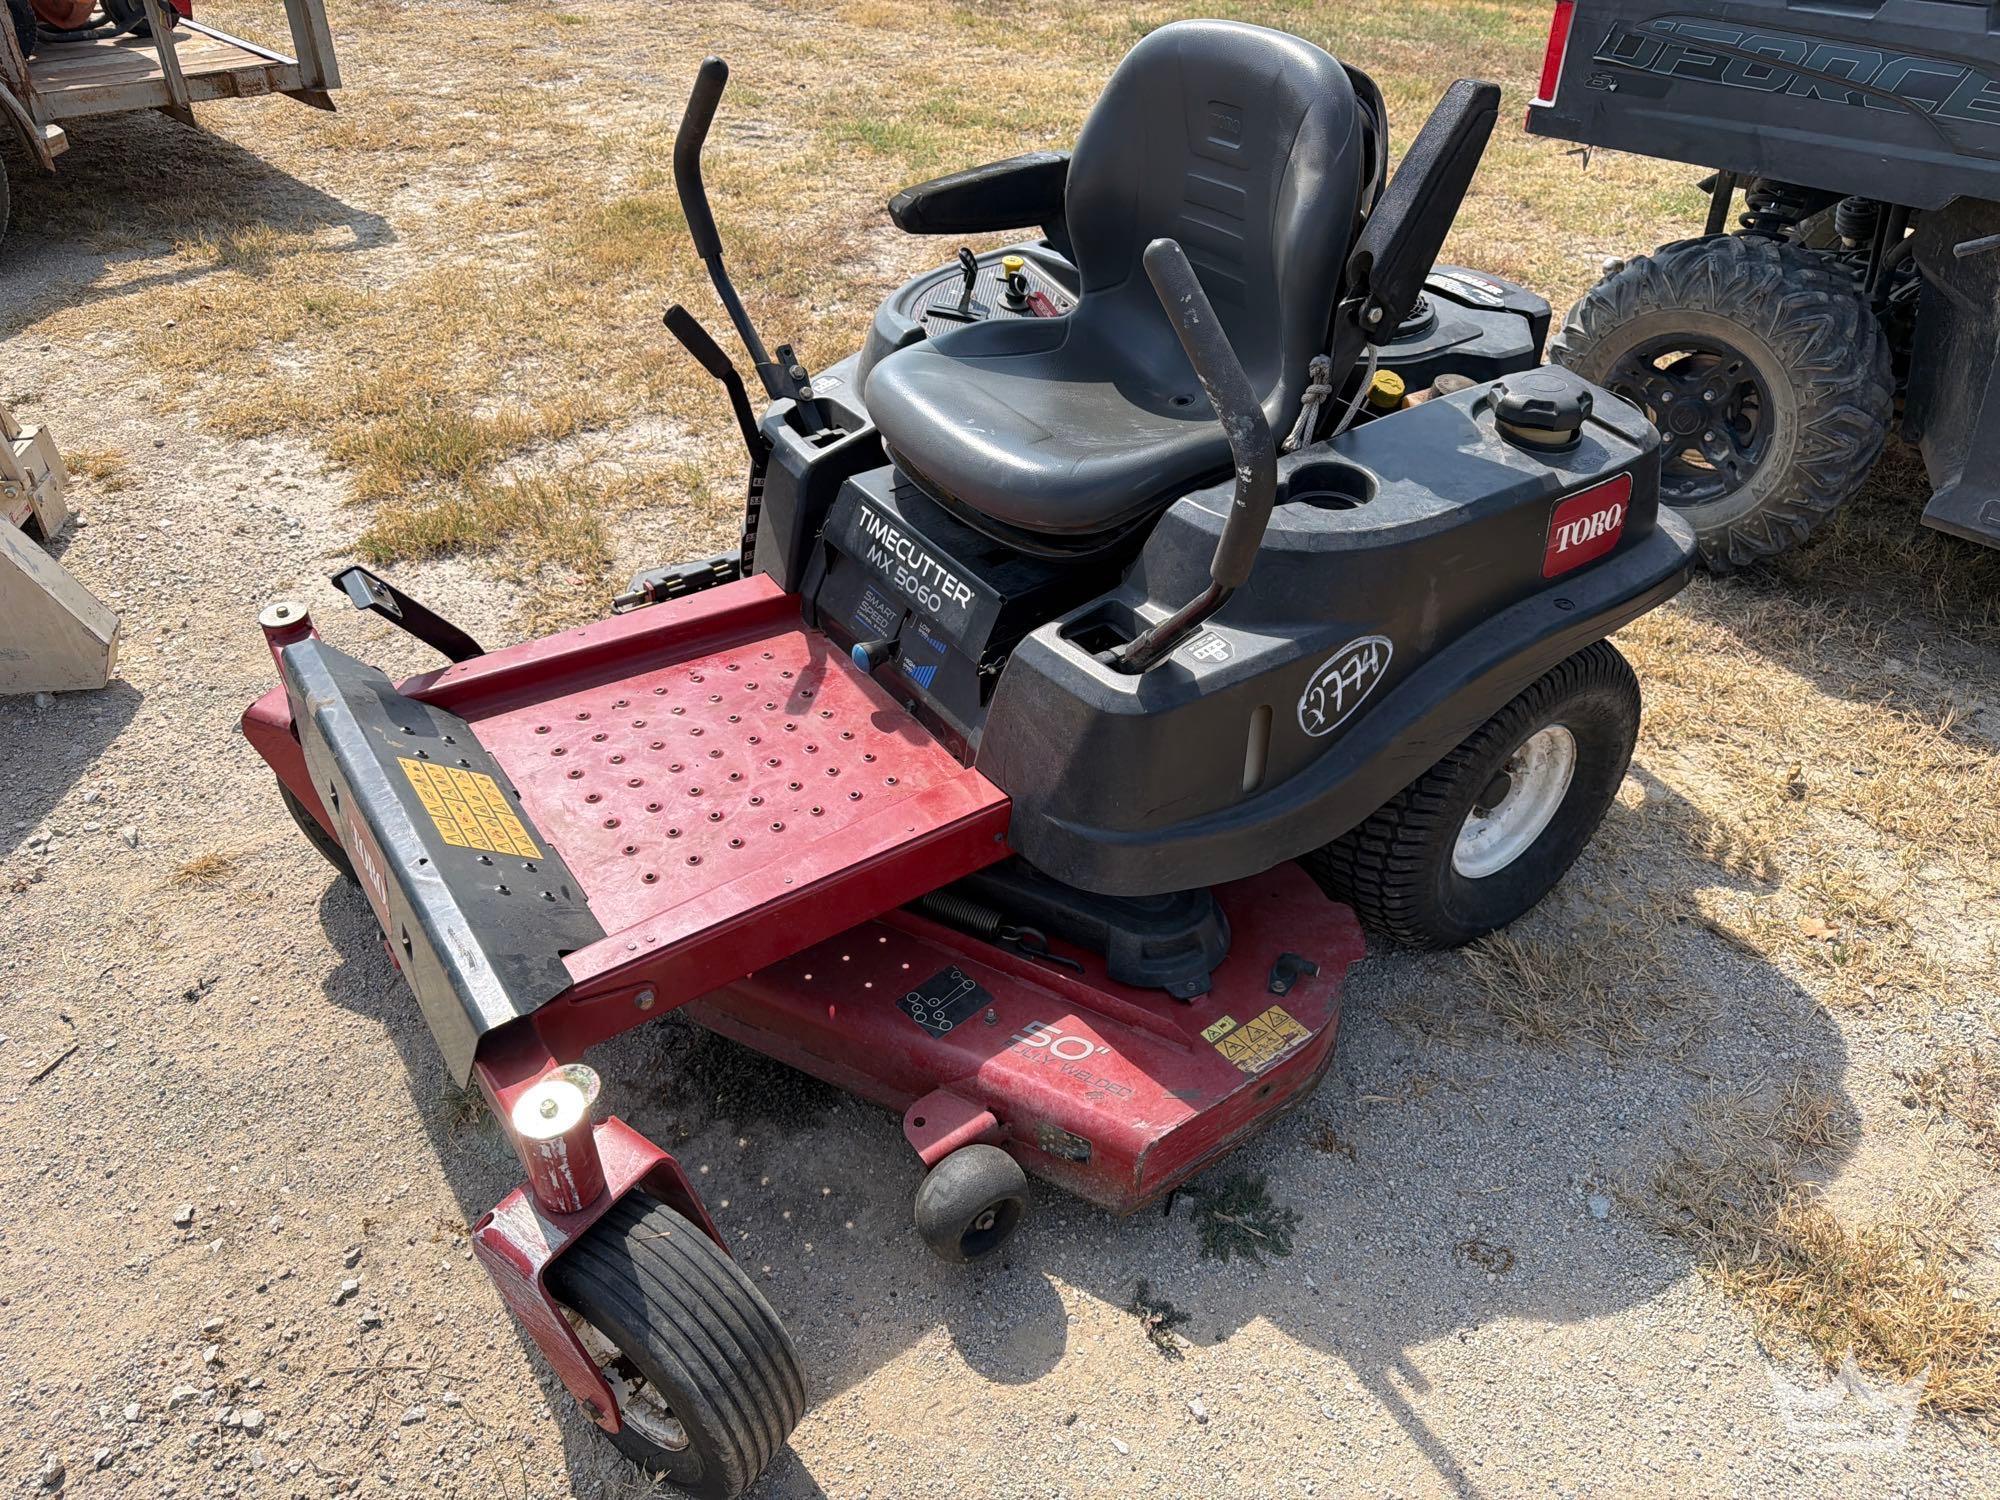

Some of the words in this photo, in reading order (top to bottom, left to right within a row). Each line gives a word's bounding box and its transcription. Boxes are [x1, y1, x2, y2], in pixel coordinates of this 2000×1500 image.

[858, 505, 971, 609] TIMECUTTER
[1555, 503, 1622, 553] TORO
[863, 590, 897, 620] SMART
[866, 545, 894, 574] MX
[894, 566, 941, 612] 5060
[859, 600, 889, 628] SPEED
[1307, 642, 1379, 731] 2774
